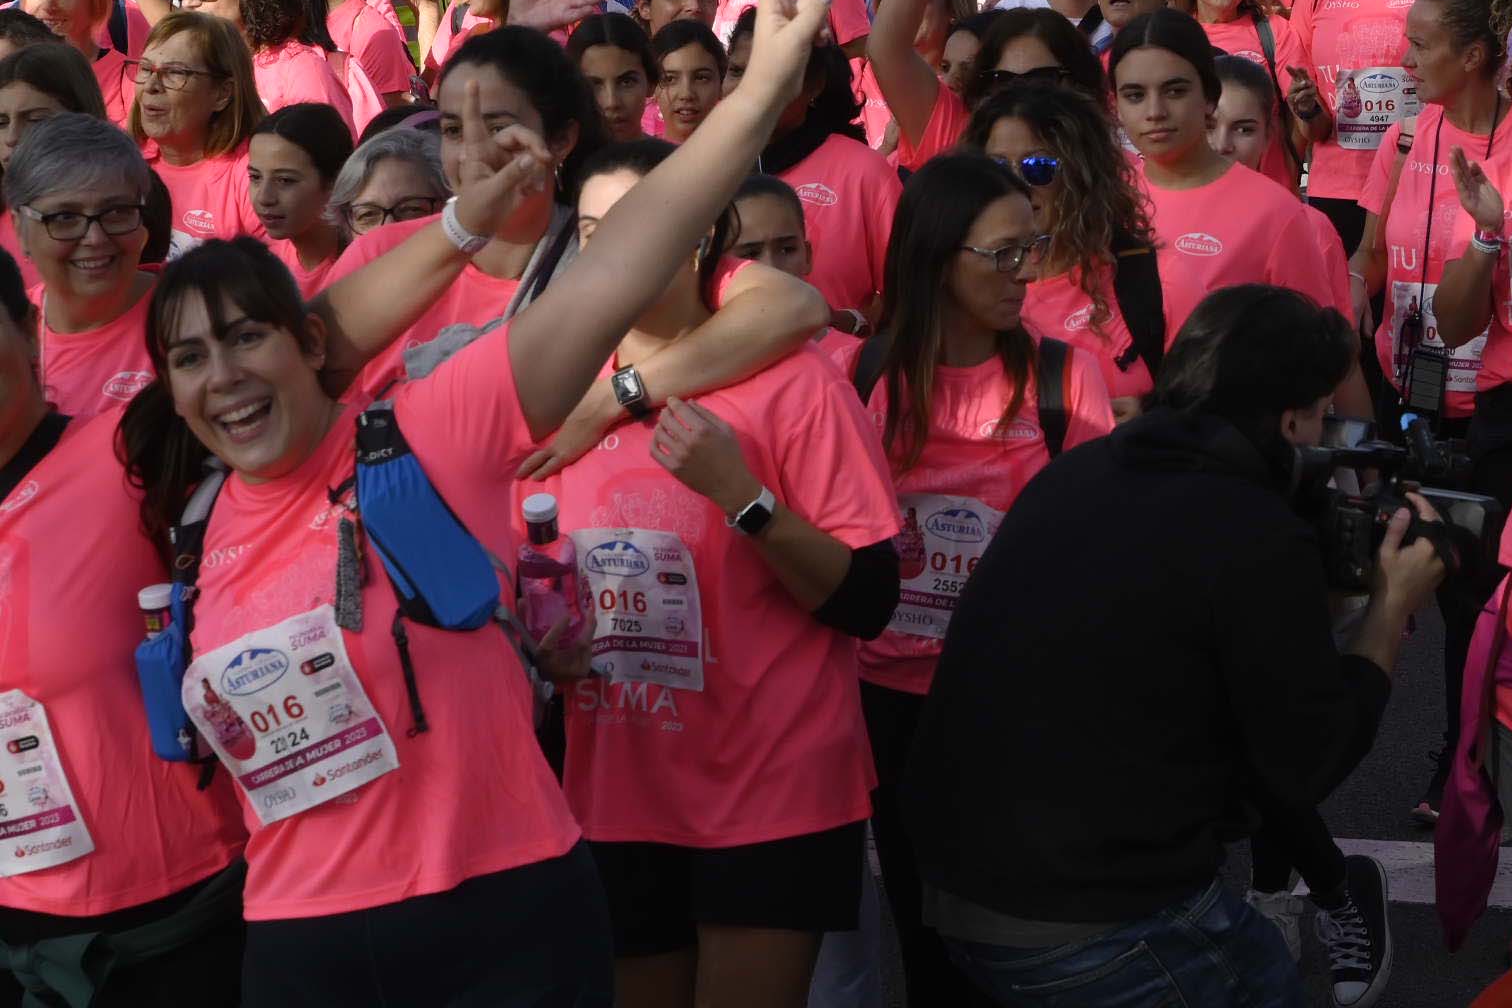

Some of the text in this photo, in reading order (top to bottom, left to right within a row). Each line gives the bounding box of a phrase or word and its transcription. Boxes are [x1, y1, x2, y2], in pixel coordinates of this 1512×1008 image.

[1364, 99, 1395, 112] 016
[1370, 115, 1389, 123] 4947
[1391, 245, 1417, 271] TU
[654, 552, 683, 562] SUMA
[599, 588, 647, 613] 016
[900, 592, 934, 605] ARRERA
[611, 617, 643, 633] 7025
[290, 629, 327, 651] SUMA
[226, 659, 285, 692] ASTURIANA
[250, 694, 305, 734] 016
[327, 748, 384, 783] Santander
